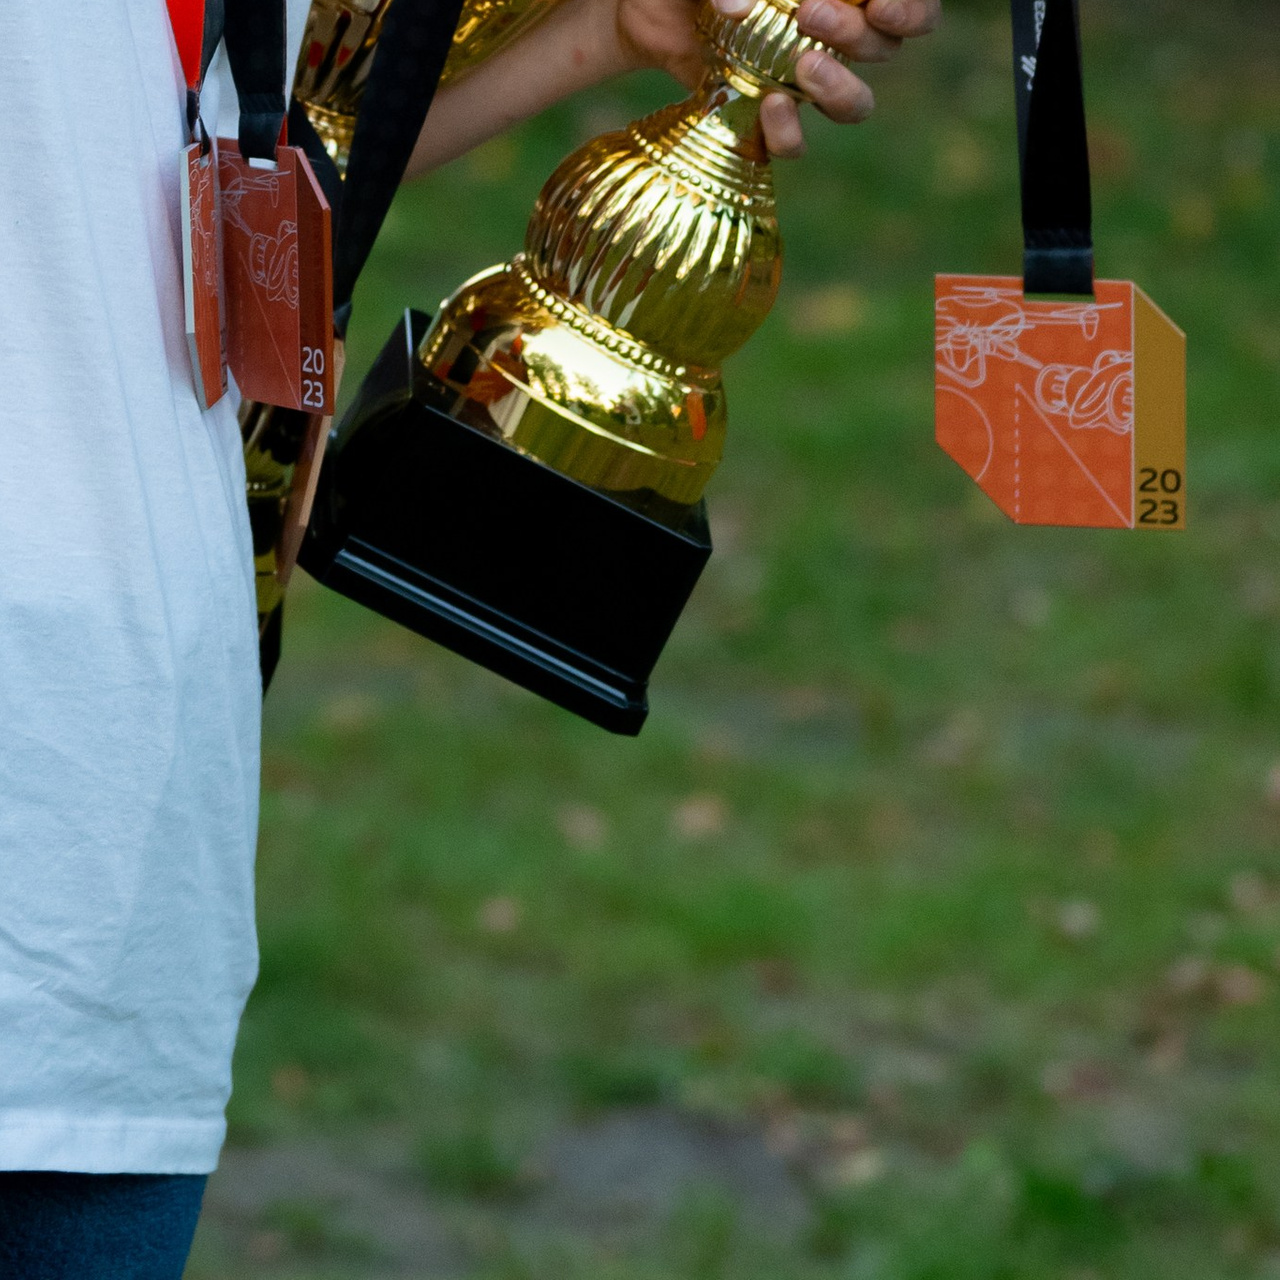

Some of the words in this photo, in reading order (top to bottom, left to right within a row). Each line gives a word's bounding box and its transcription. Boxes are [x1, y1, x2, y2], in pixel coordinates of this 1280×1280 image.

[302, 346, 325, 375] 20
[303, 379, 325, 409] 23
[1139, 467, 1182, 494] 20
[1139, 498, 1179, 525] 23
